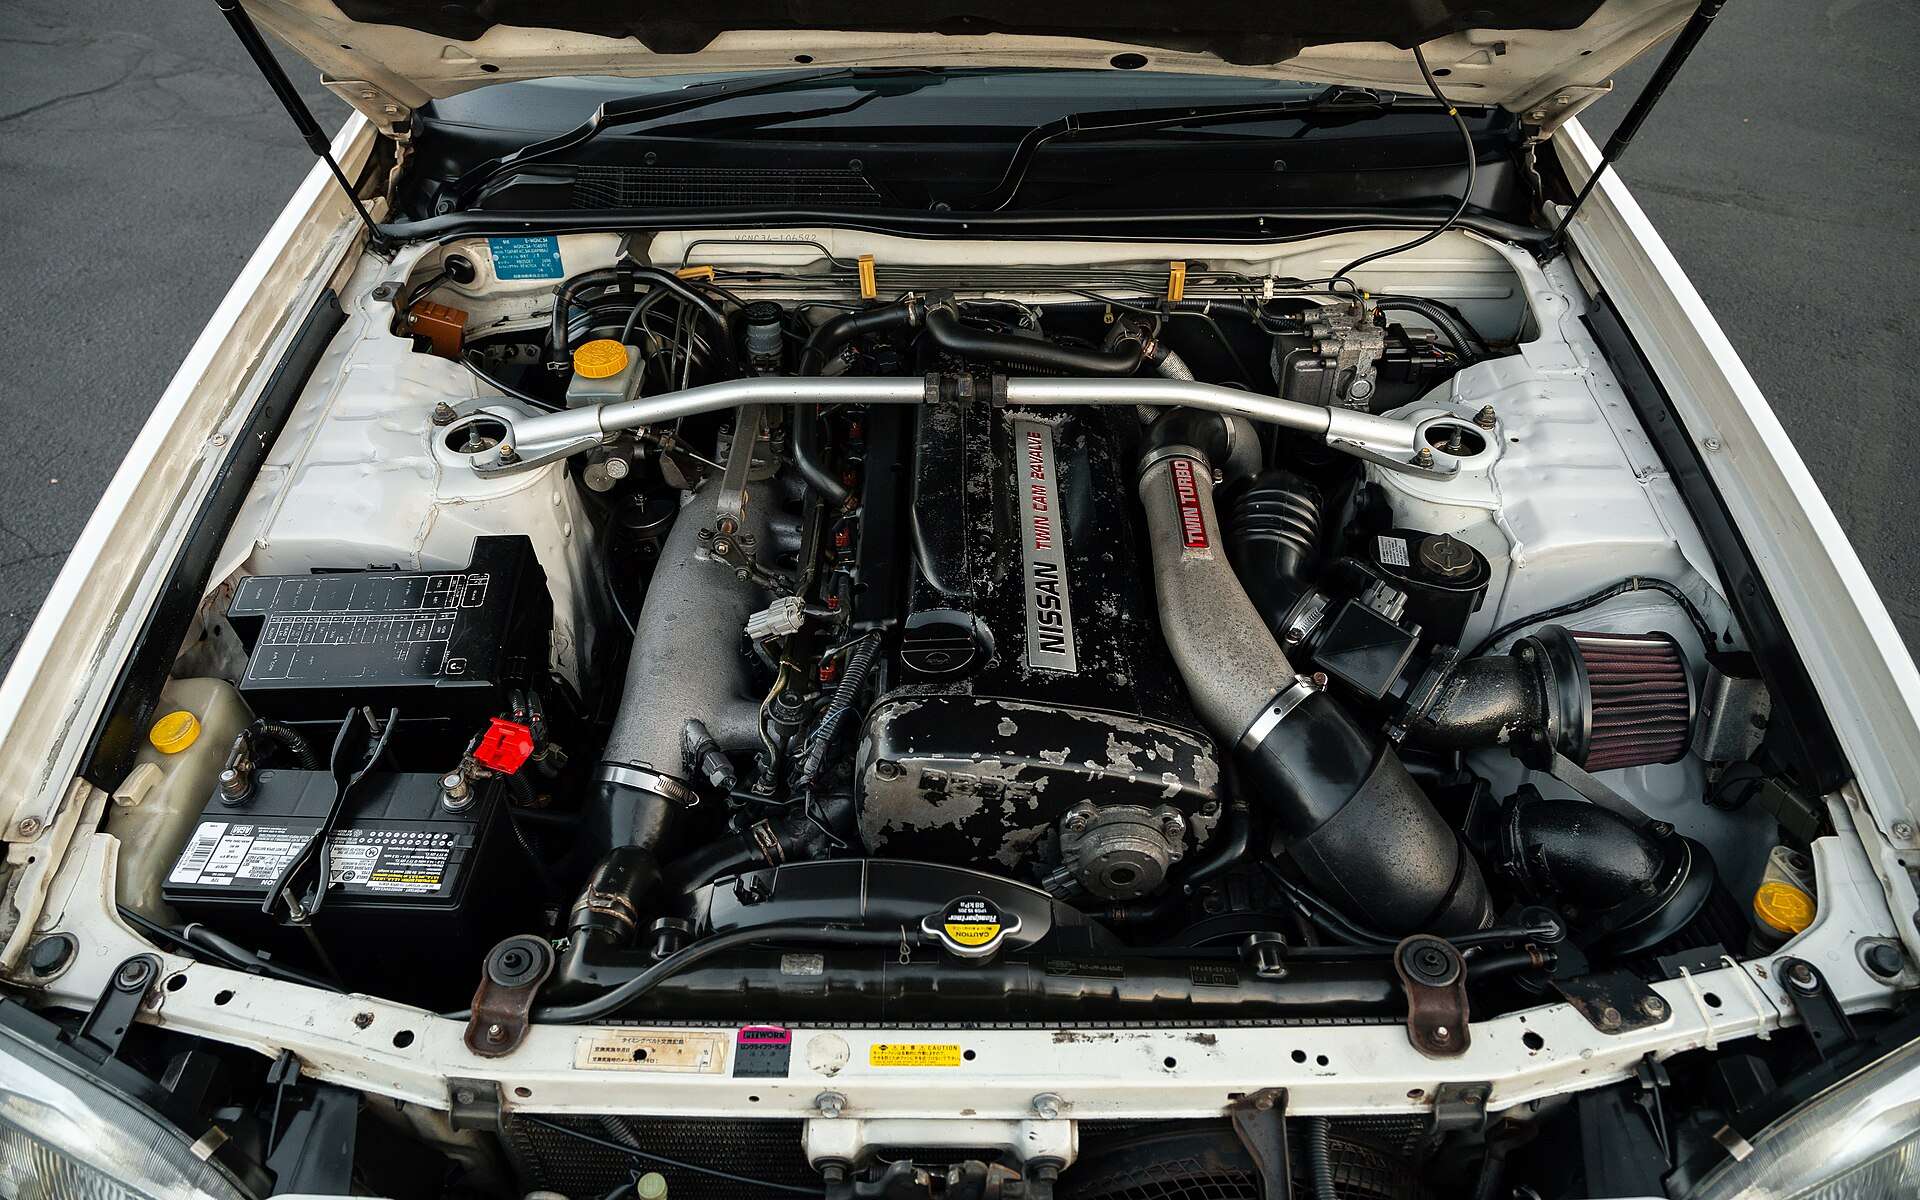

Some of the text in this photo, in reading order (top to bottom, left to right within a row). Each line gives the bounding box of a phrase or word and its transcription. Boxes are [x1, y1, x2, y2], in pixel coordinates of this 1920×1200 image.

[1174, 460, 1204, 543] TWIN TURBO
[1027, 432, 1066, 656] NISSAN TWIN CAM 24VALVE
[232, 826, 252, 834] AGM
